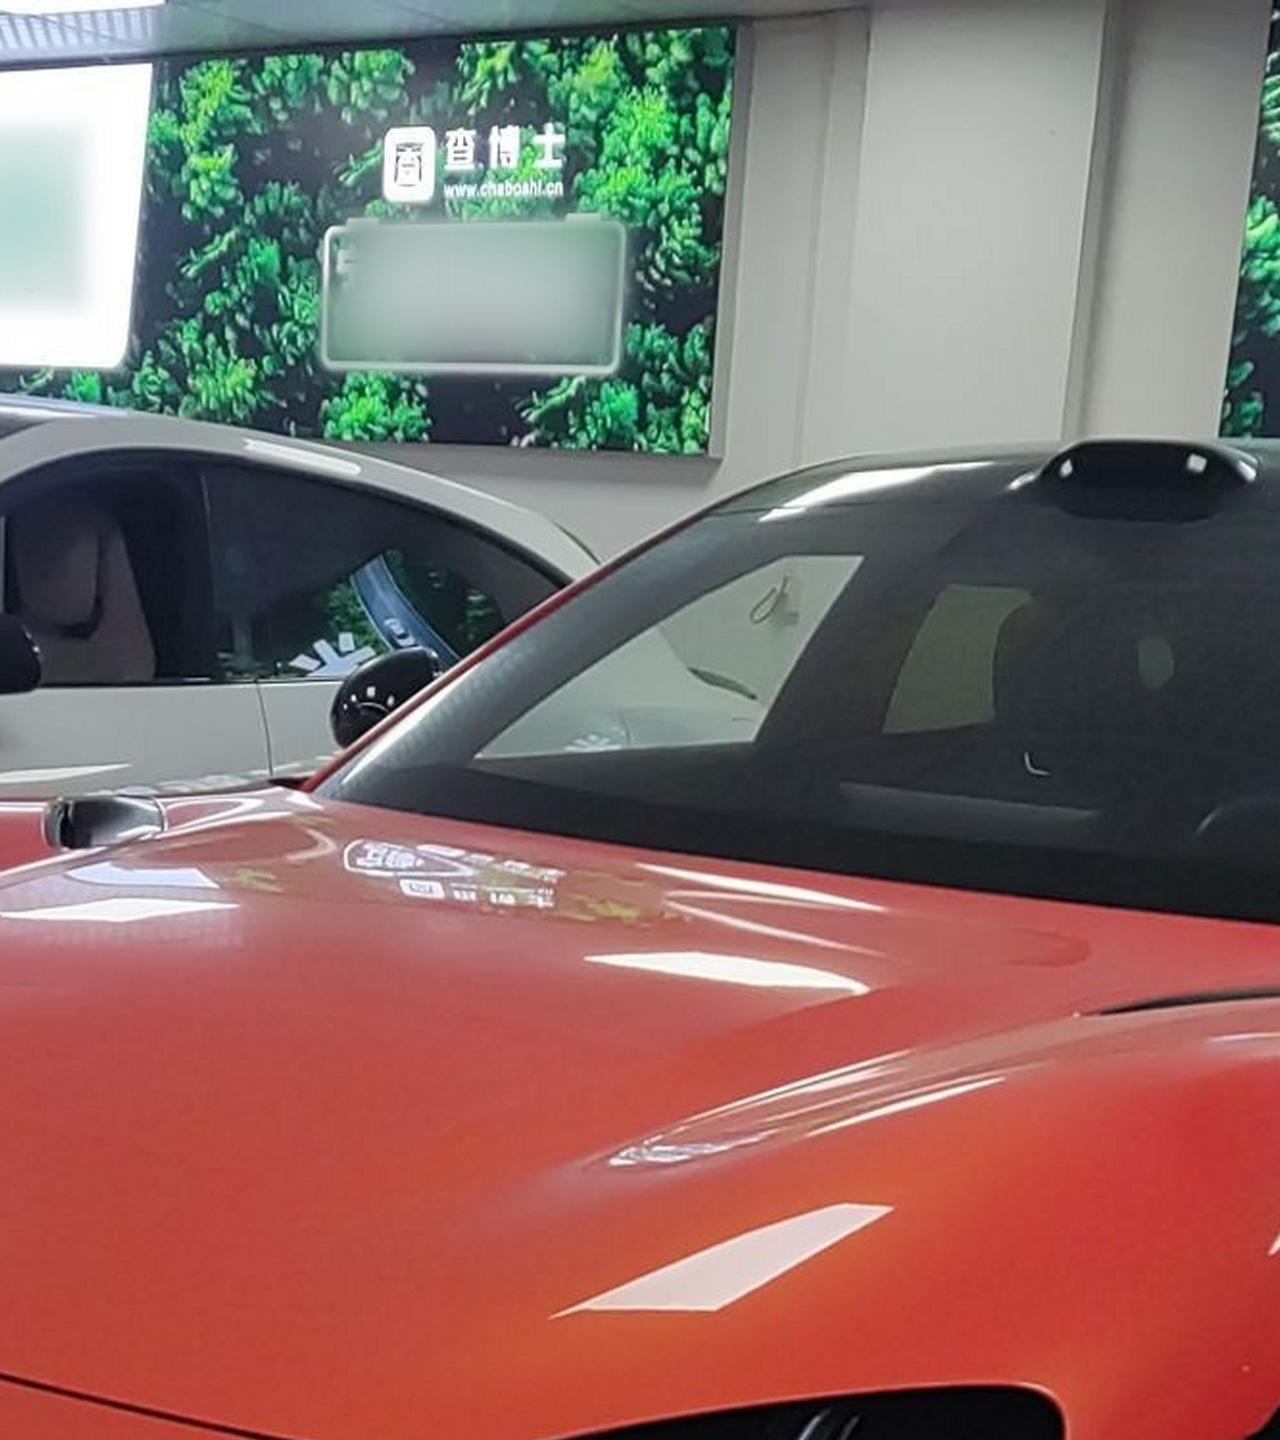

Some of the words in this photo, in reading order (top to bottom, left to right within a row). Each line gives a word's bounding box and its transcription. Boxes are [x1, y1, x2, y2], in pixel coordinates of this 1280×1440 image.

[444, 121, 567, 171] 查博士
[444, 179, 564, 198] www.chaboshi.cn
